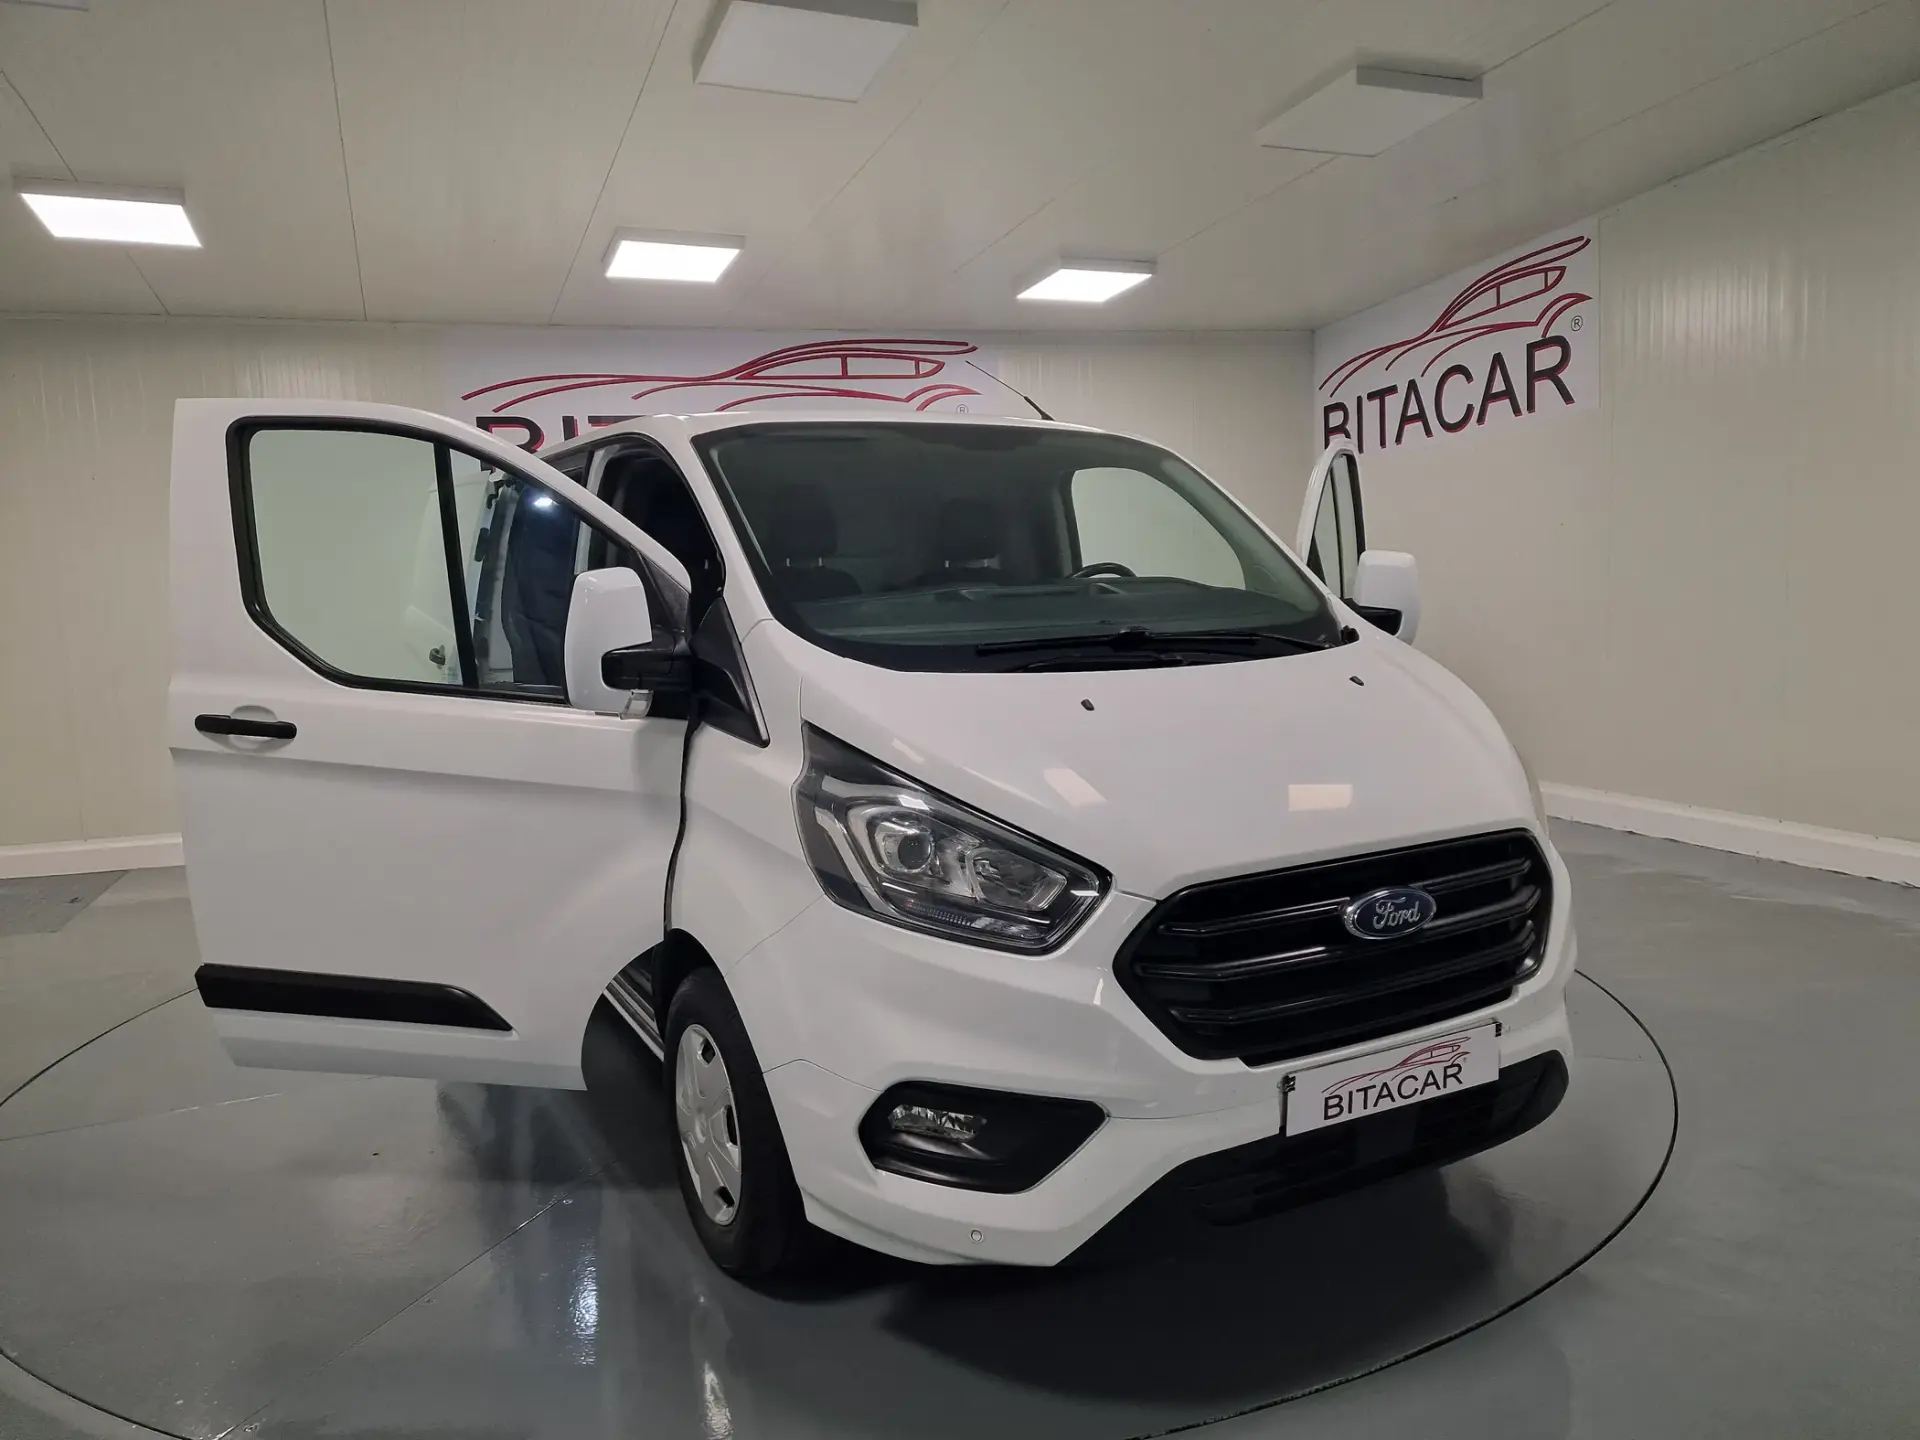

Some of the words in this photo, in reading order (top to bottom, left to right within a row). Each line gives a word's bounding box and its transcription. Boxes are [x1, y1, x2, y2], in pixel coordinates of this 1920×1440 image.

[1323, 335, 1575, 454] BITACAR
[1372, 896, 1421, 930] Ford
[1324, 1063, 1463, 1121] BITACAR
